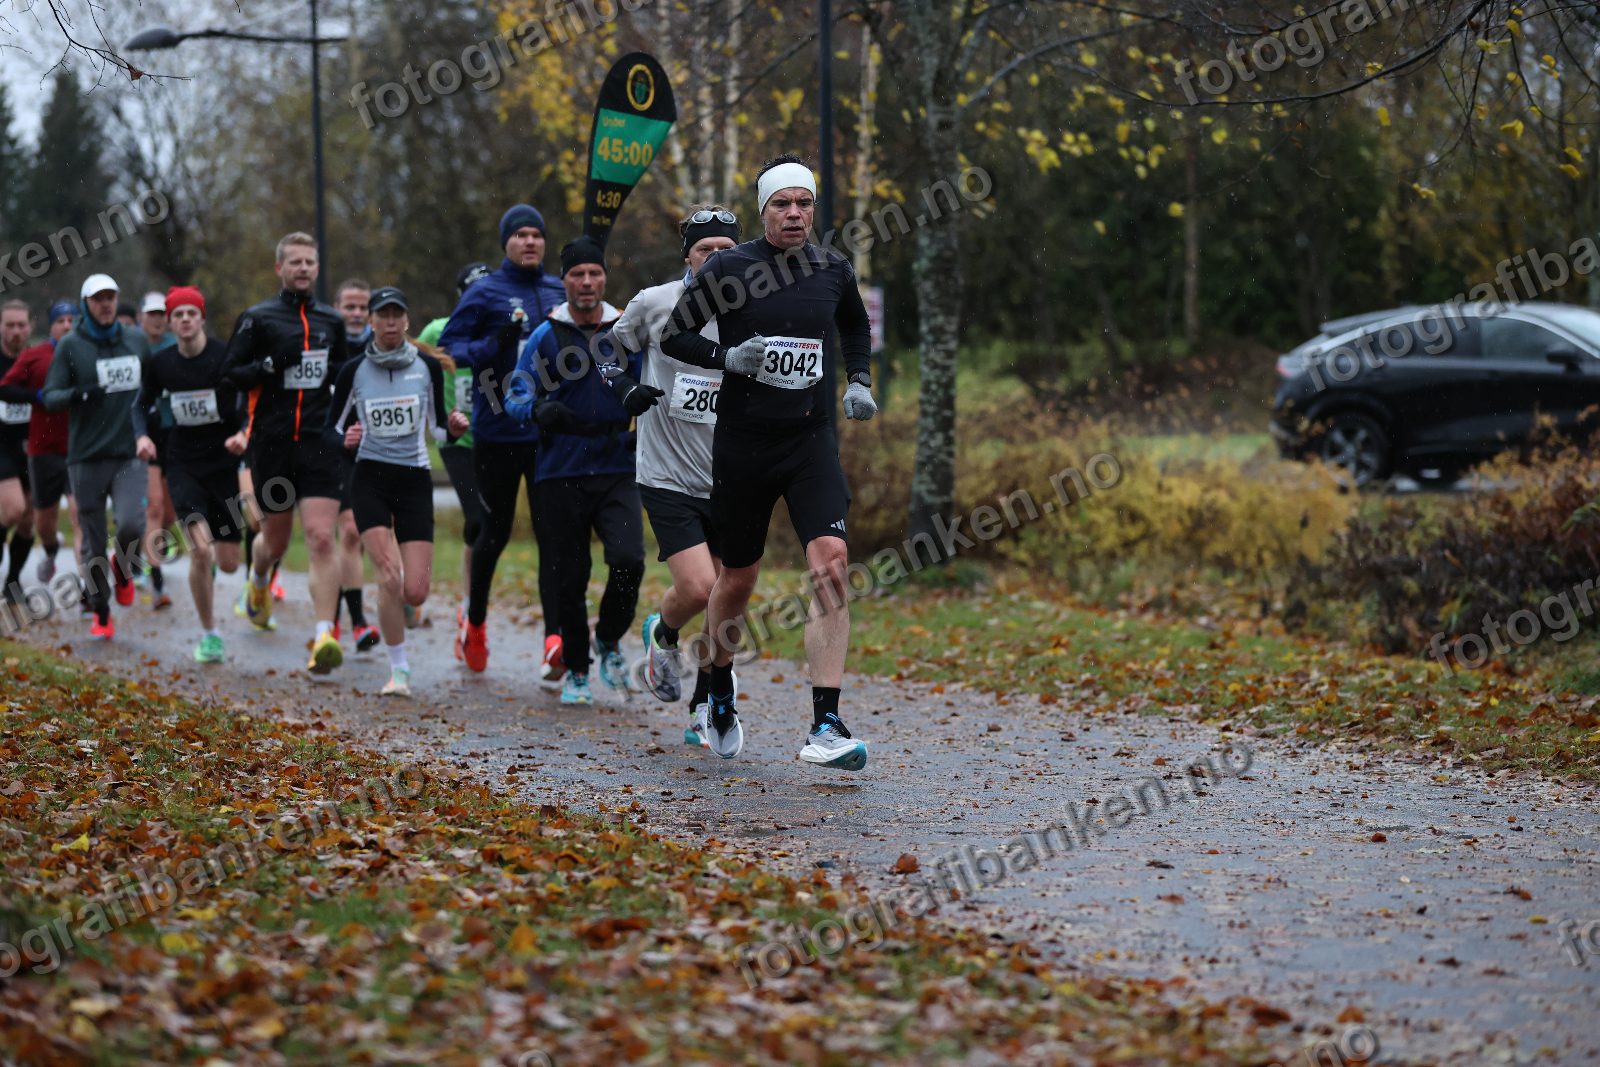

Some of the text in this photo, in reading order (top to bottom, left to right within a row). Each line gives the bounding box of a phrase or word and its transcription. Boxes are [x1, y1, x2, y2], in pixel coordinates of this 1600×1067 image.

[597, 136, 653, 167] 45:00
[294, 360, 323, 380] 385
[764, 350, 818, 377] 3042
[107, 366, 133, 384] 562
[180, 400, 208, 417] 165
[682, 388, 721, 414] 280
[371, 406, 414, 428] 9361
